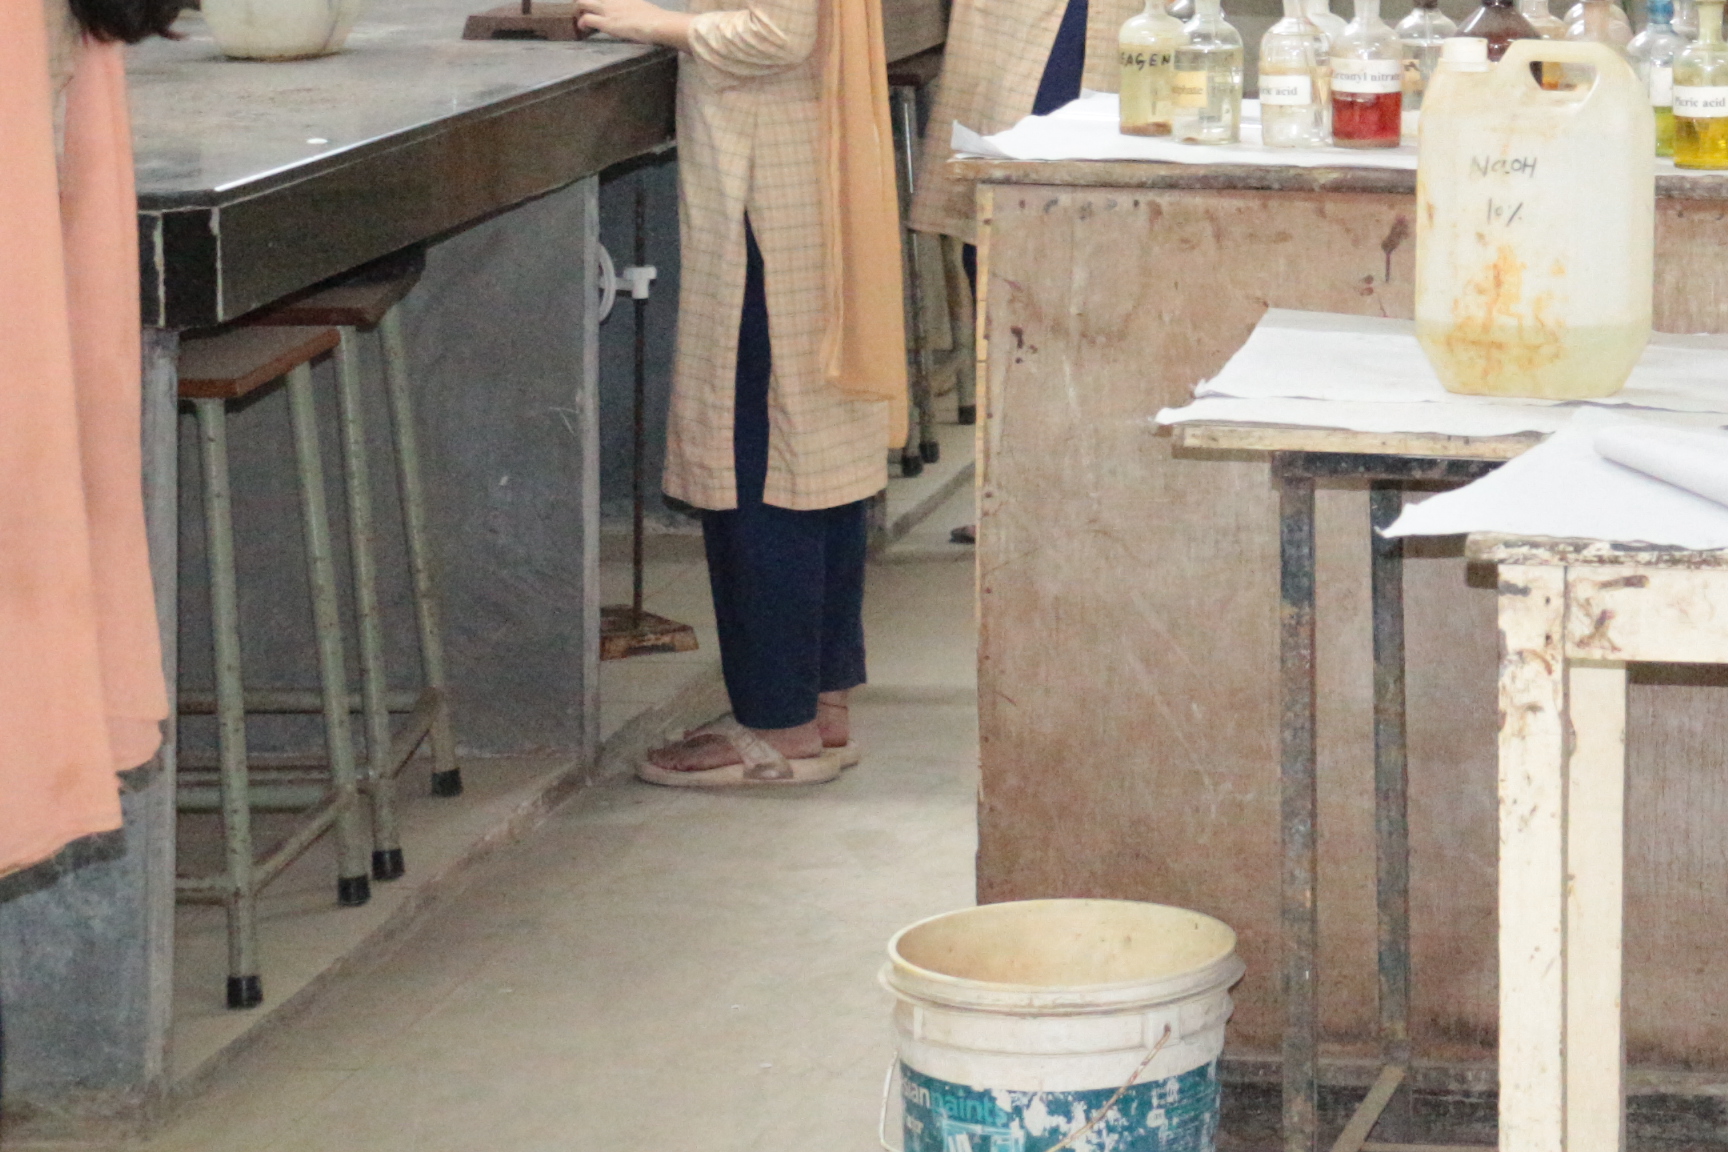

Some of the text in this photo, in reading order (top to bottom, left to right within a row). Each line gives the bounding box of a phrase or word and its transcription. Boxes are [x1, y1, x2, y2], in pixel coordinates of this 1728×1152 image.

[1275, 87, 1298, 96] acid
[1702, 96, 1726, 108] acid
[1471, 156, 1537, 178] NaOH
